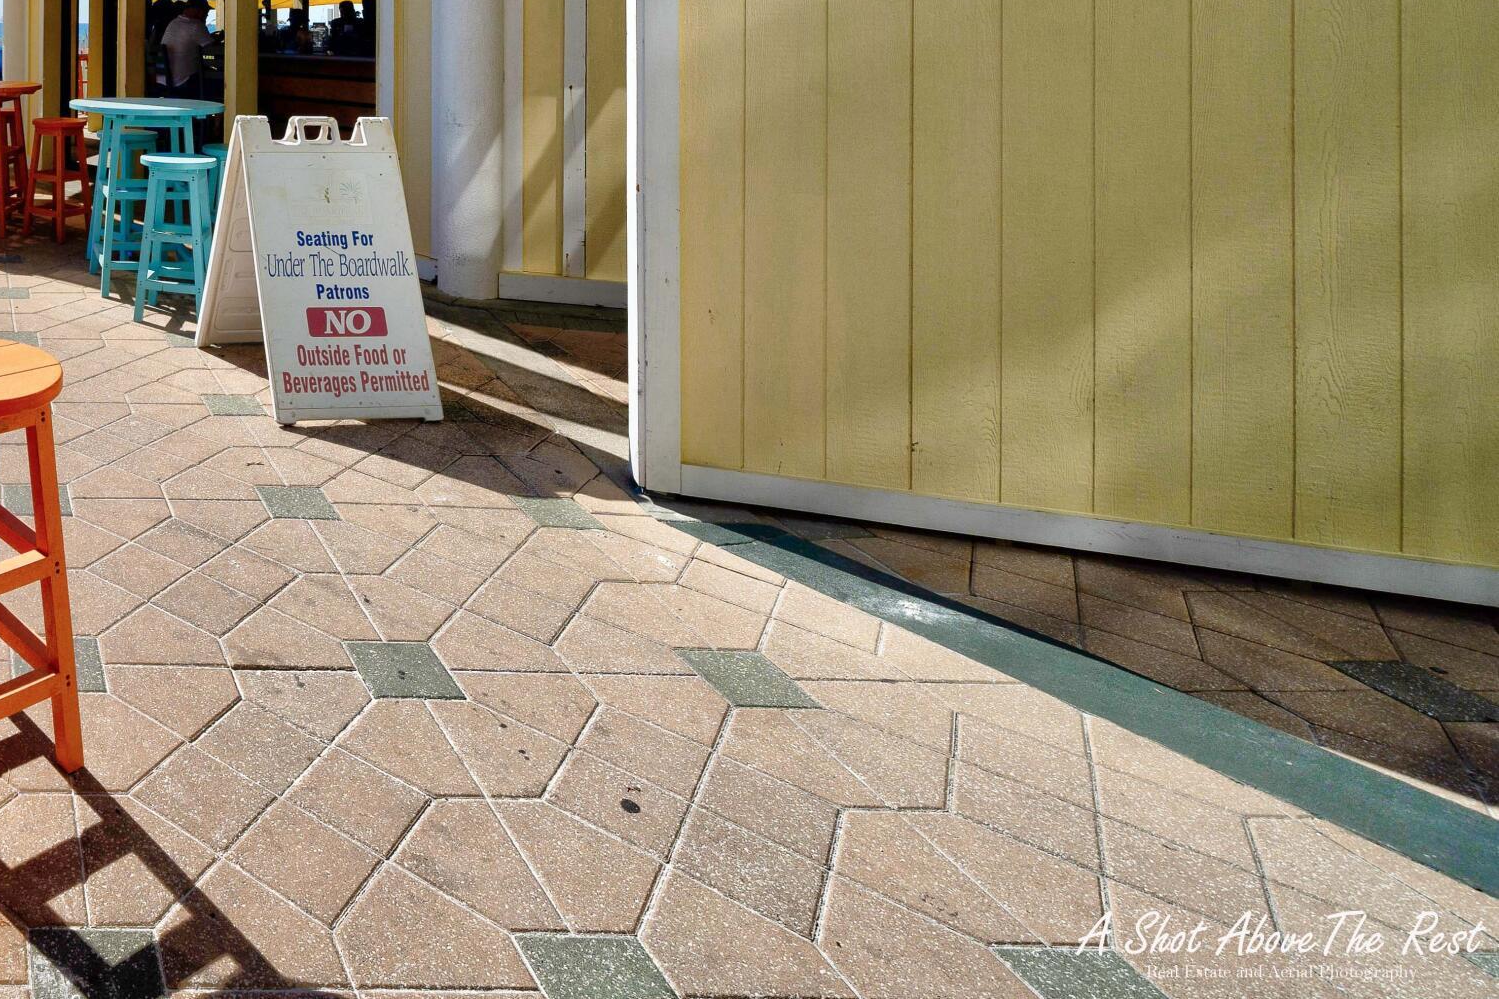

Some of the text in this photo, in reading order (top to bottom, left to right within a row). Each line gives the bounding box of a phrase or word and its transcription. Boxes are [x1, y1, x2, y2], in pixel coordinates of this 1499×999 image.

[296, 230, 373, 249] Seating For
[267, 251, 410, 277] Under The Boardwalk
[316, 284, 370, 299] Patrons
[324, 310, 372, 334] NO
[297, 344, 406, 366] Outside Food or
[282, 370, 430, 397] Beverages Permitted
